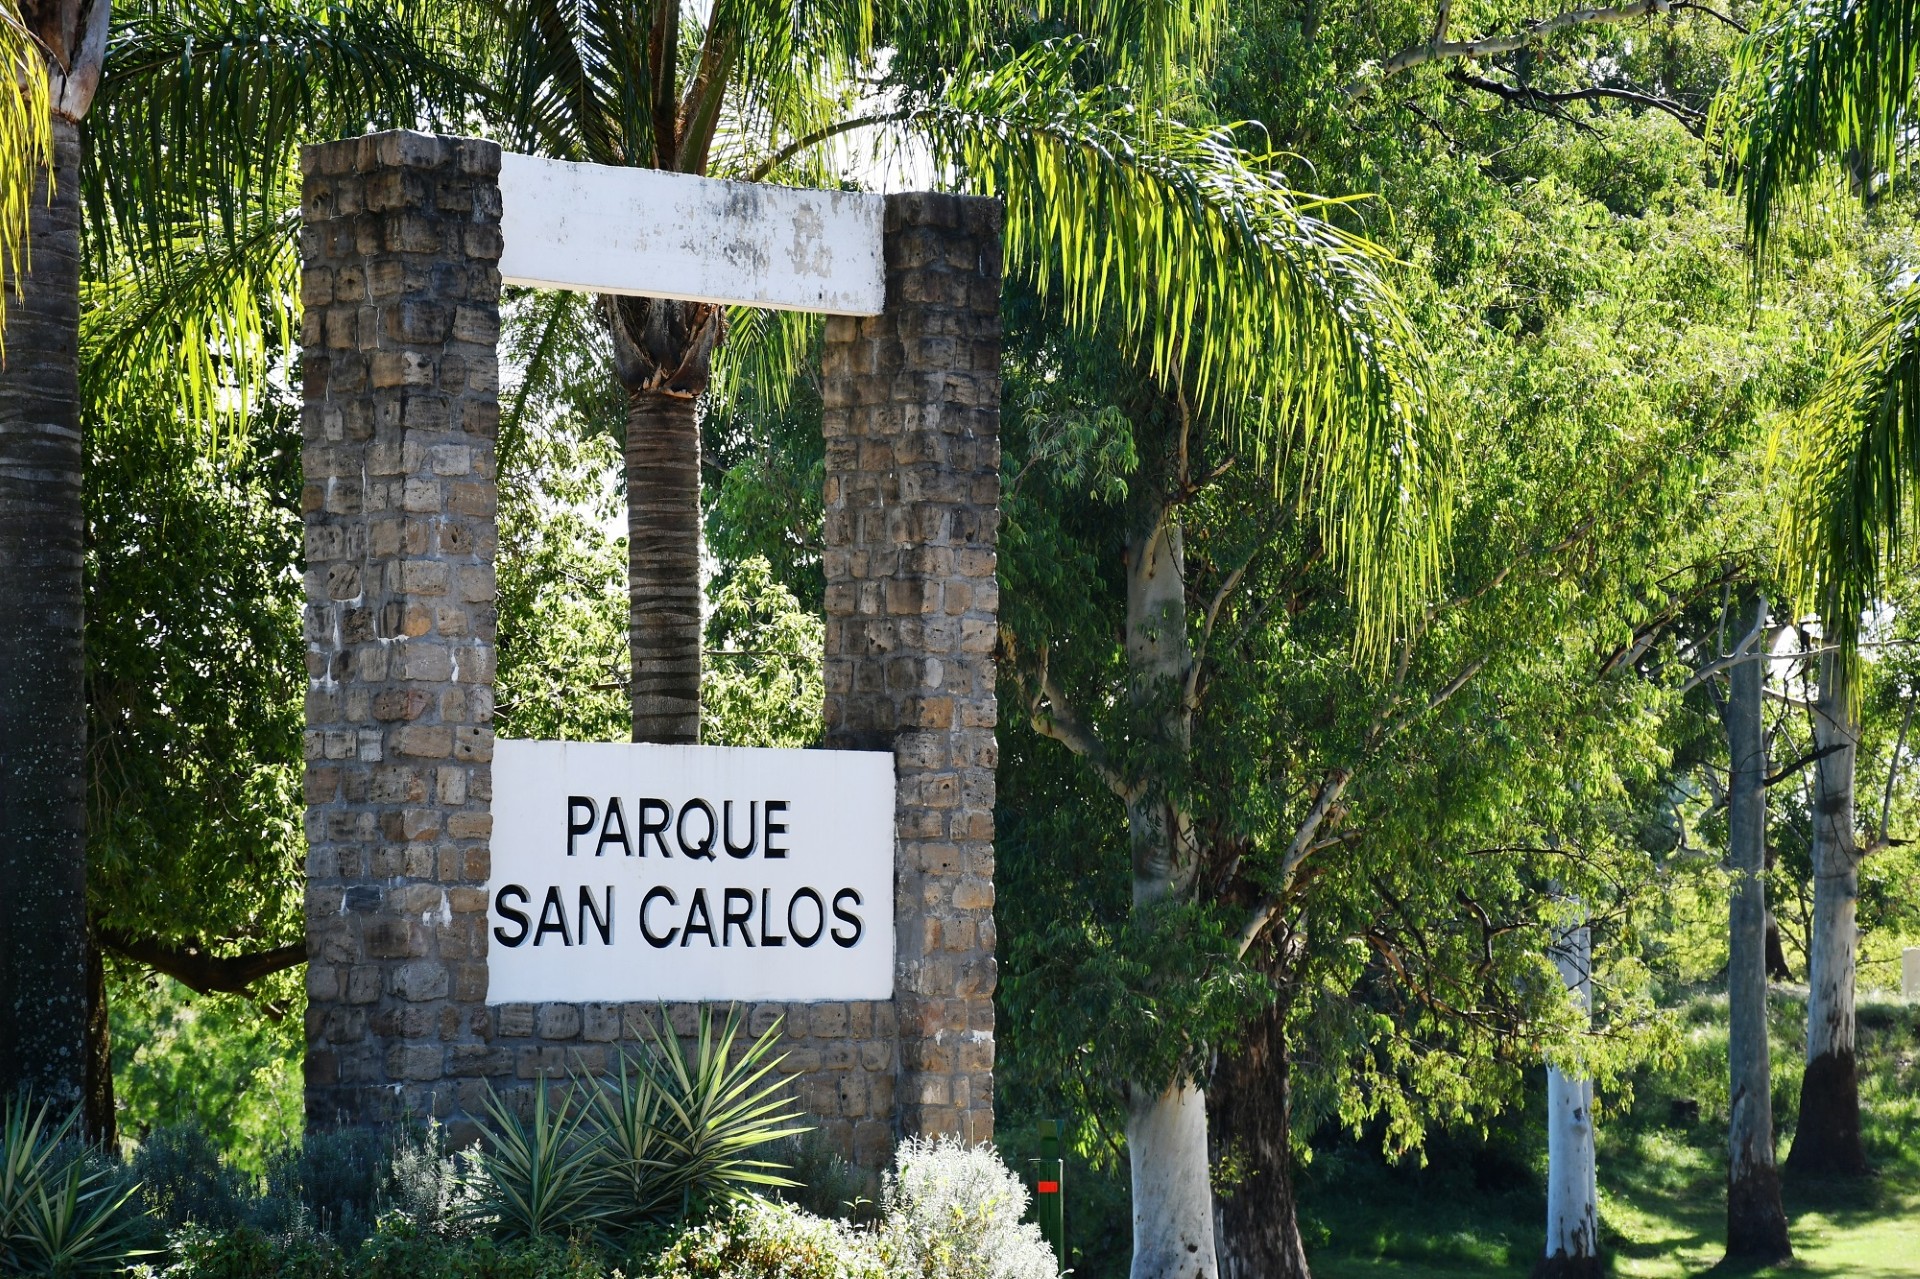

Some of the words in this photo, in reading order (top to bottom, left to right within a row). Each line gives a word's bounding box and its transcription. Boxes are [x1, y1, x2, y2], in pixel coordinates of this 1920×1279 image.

[566, 795, 791, 862] PARQUE
[493, 883, 615, 948] SAN
[639, 885, 864, 949] CARLOS
